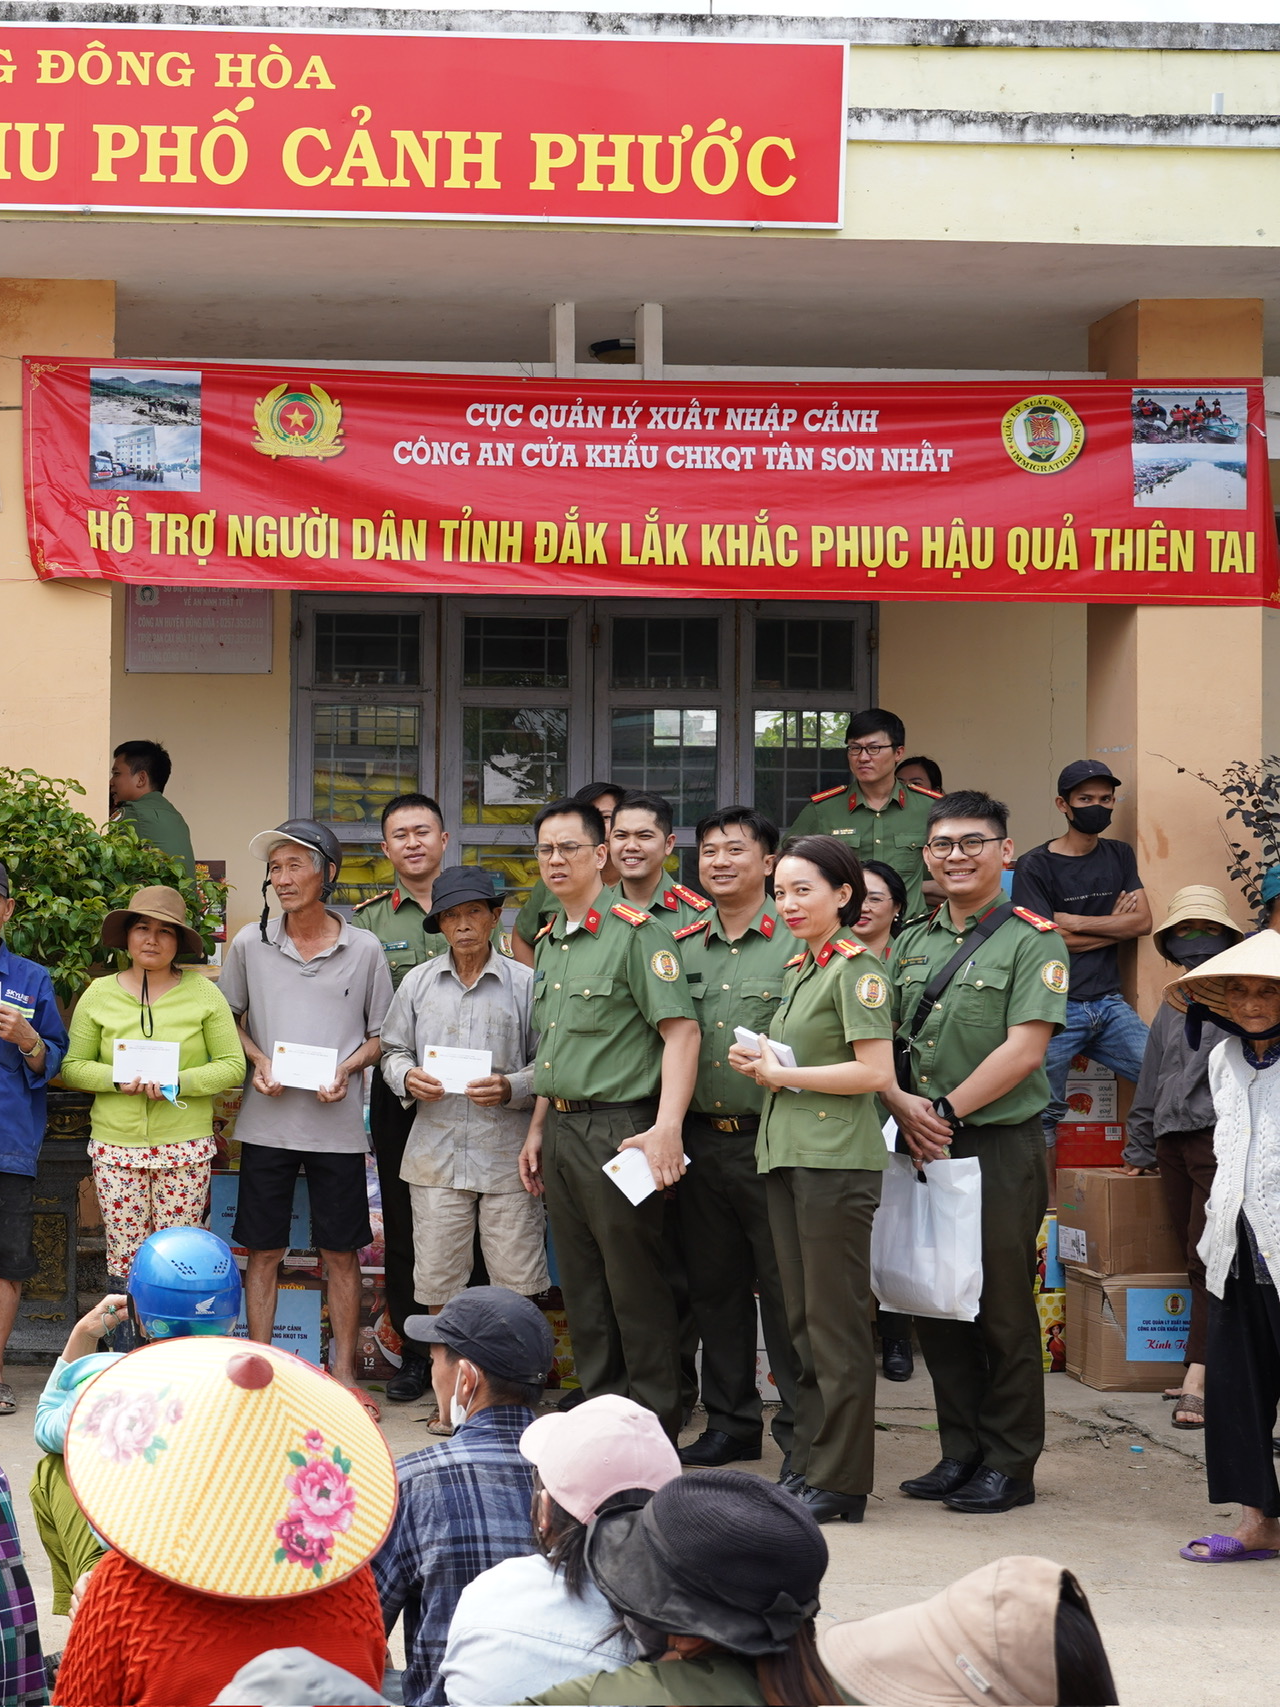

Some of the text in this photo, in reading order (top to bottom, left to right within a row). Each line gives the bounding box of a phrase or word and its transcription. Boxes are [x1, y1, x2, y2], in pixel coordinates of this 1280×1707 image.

[36, 40, 196, 88] ĐÔNG
[215, 43, 336, 89] HÒA
[91, 97, 255, 186] PHỐ
[282, 105, 502, 190] CẢNH
[529, 118, 797, 197] PHƯỚC
[465, 397, 879, 438] CỤC QUẢN LÝ XUẤT NHẬP CẢNH
[394, 431, 954, 473] CÔNG AN CỬA KHẨU CHKQT TÂN SƠN NHẤT
[1011, 449, 1076, 473] IMMIGRATION
[87, 496, 1255, 578] HỖ TRỢ NGƯỜI DÂN TỈNH ĐẮK LẮK KHẮC PHỤC HẬU QUẢ THIÊN TAI
[364, 1358, 374, 1366] 12
